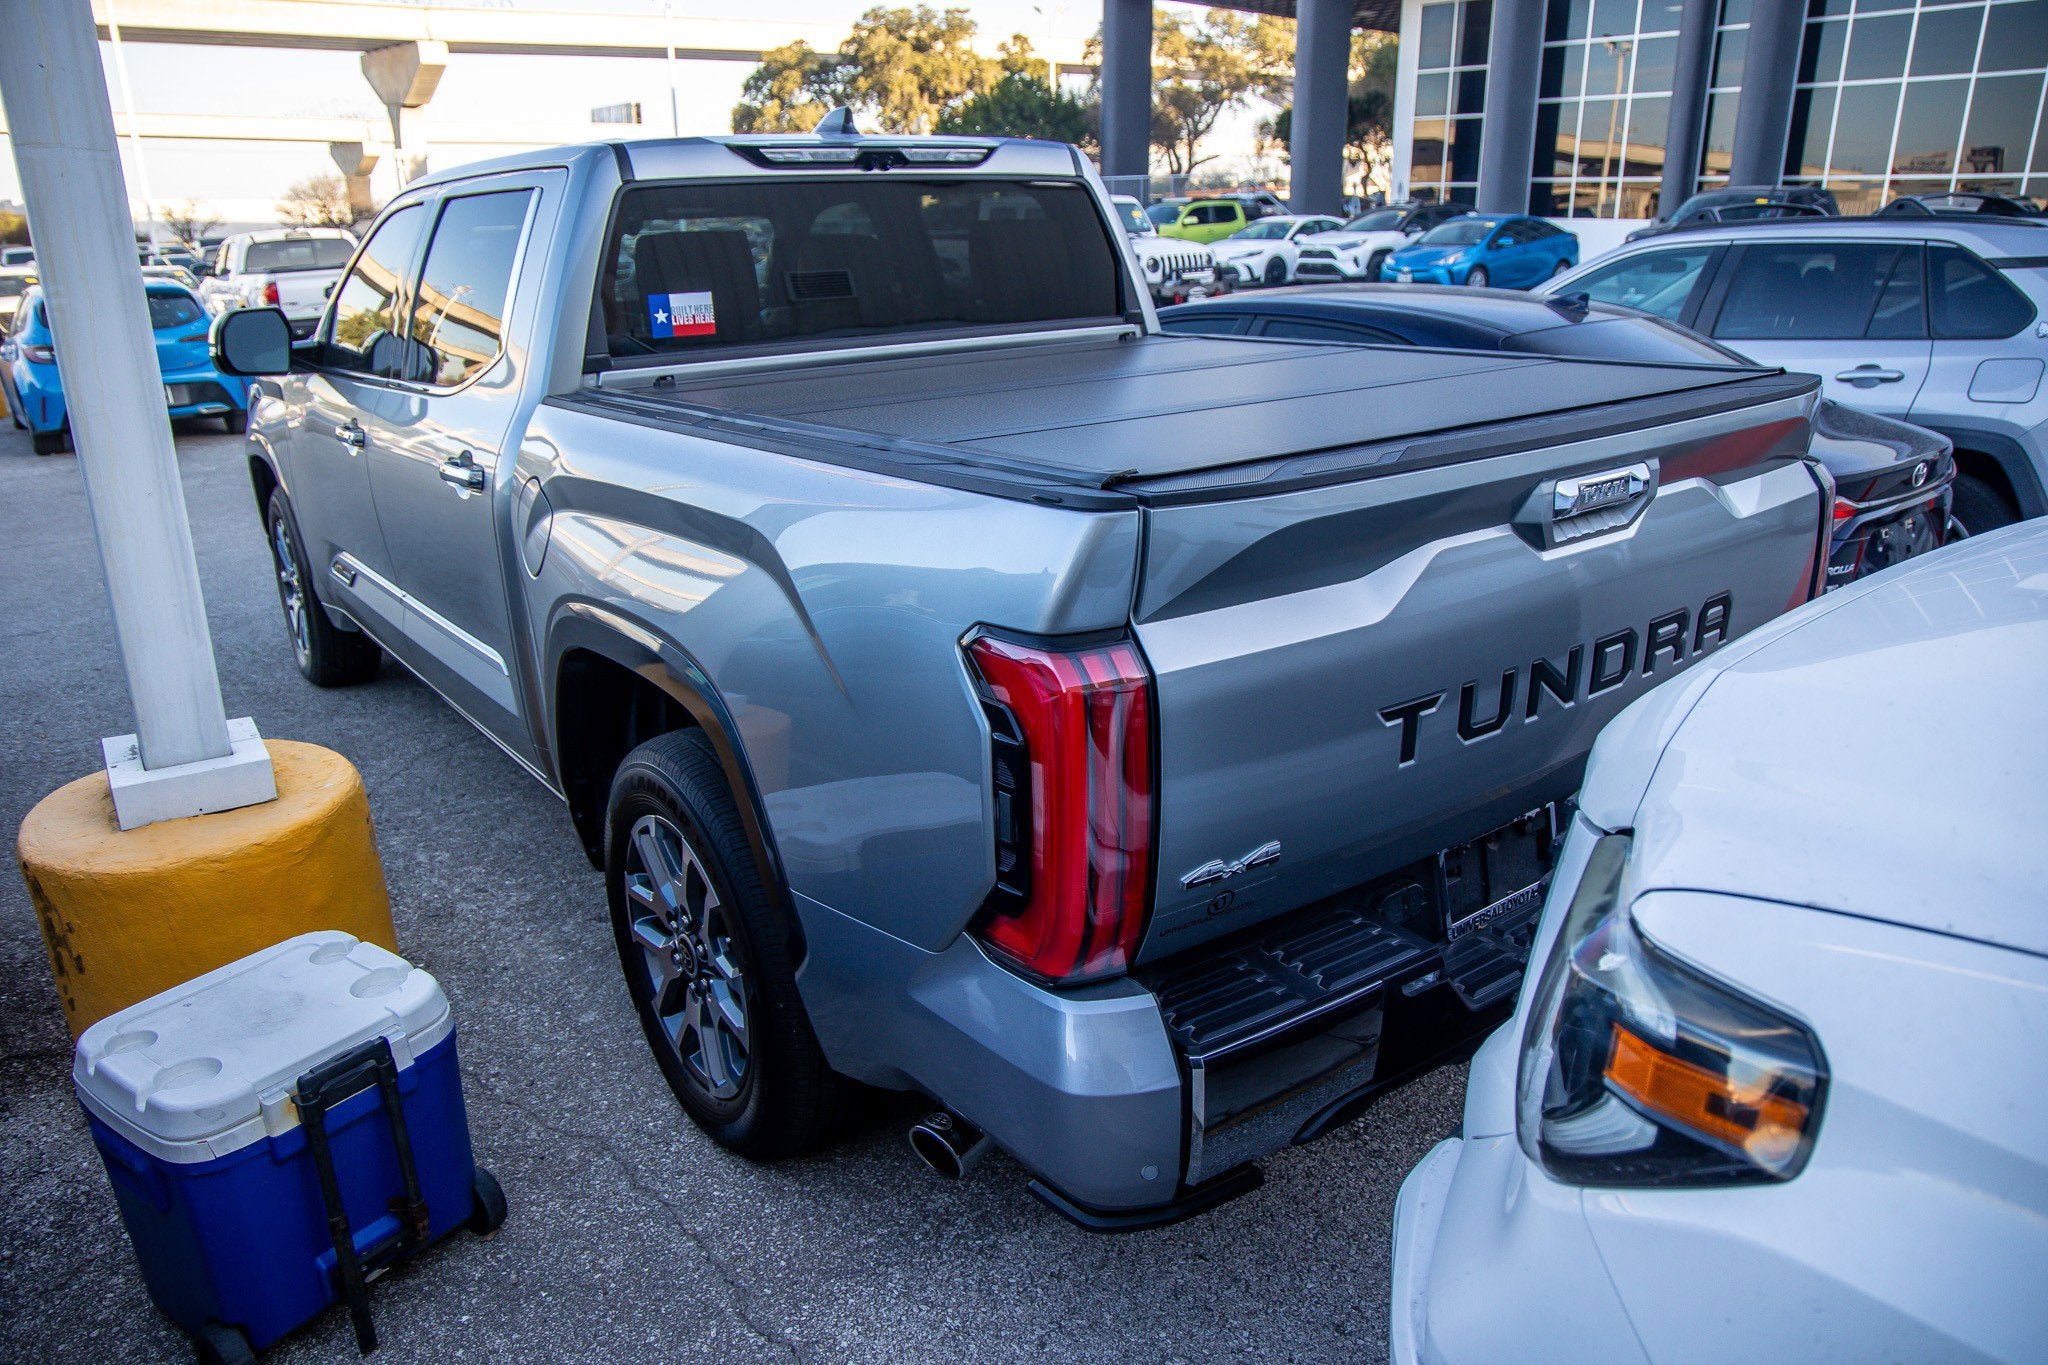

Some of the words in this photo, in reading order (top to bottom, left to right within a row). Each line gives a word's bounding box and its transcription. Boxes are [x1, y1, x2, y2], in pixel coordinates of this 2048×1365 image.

[671, 314, 694, 326] LIVES
[695, 311, 715, 325] HERE
[694, 303, 714, 314] HERE
[1582, 479, 1627, 503] TOYOTA
[1376, 589, 1734, 768] TUNDRA
[1159, 914, 1216, 938] UNIVERSAL
[1219, 900, 1256, 918] TOYOTA
